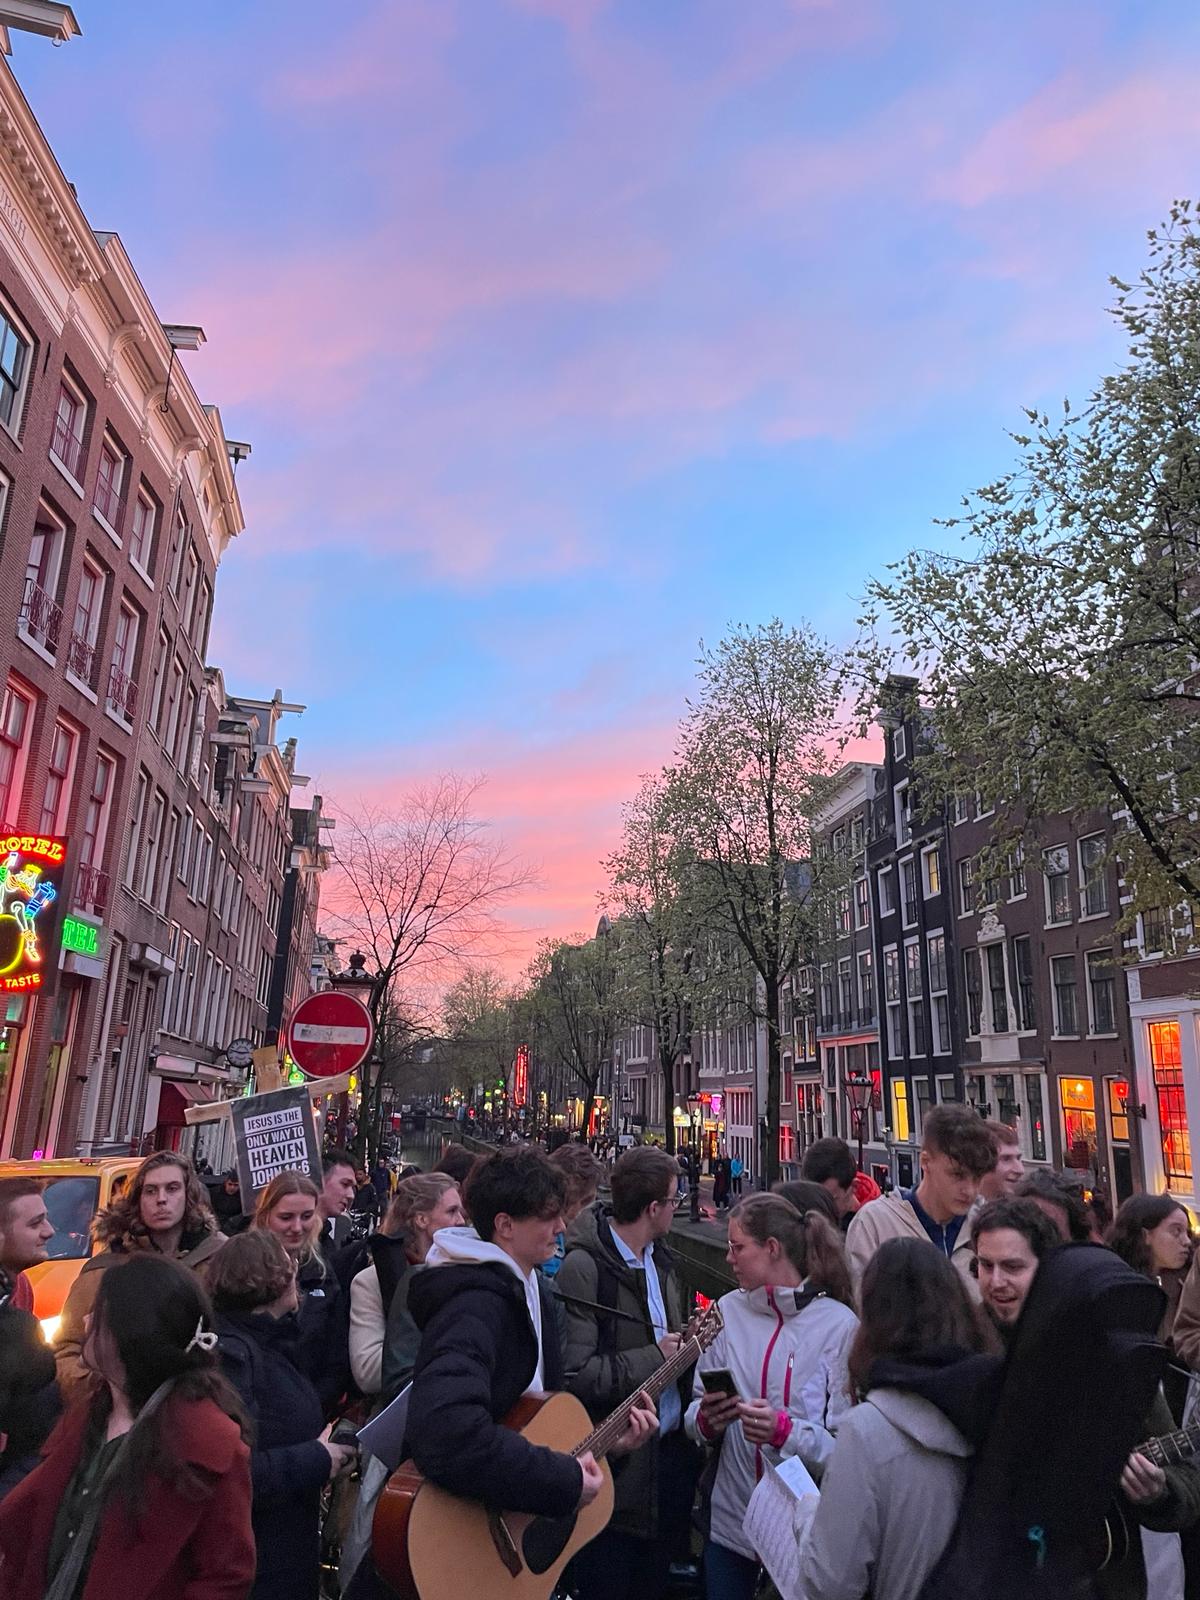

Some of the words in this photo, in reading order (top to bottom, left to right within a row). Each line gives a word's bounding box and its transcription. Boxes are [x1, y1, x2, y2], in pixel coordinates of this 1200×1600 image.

[5, 973, 41, 988] TASTE
[248, 1116, 273, 1130] JESUS
[274, 1114, 283, 1124] IS
[285, 1110, 299, 1122] THE
[246, 1133, 270, 1148] ONLY
[271, 1129, 292, 1143] WAY
[292, 1126, 304, 1138] TO
[252, 1142, 304, 1167] HEAVEN
[252, 1166, 282, 1187] JOHN
